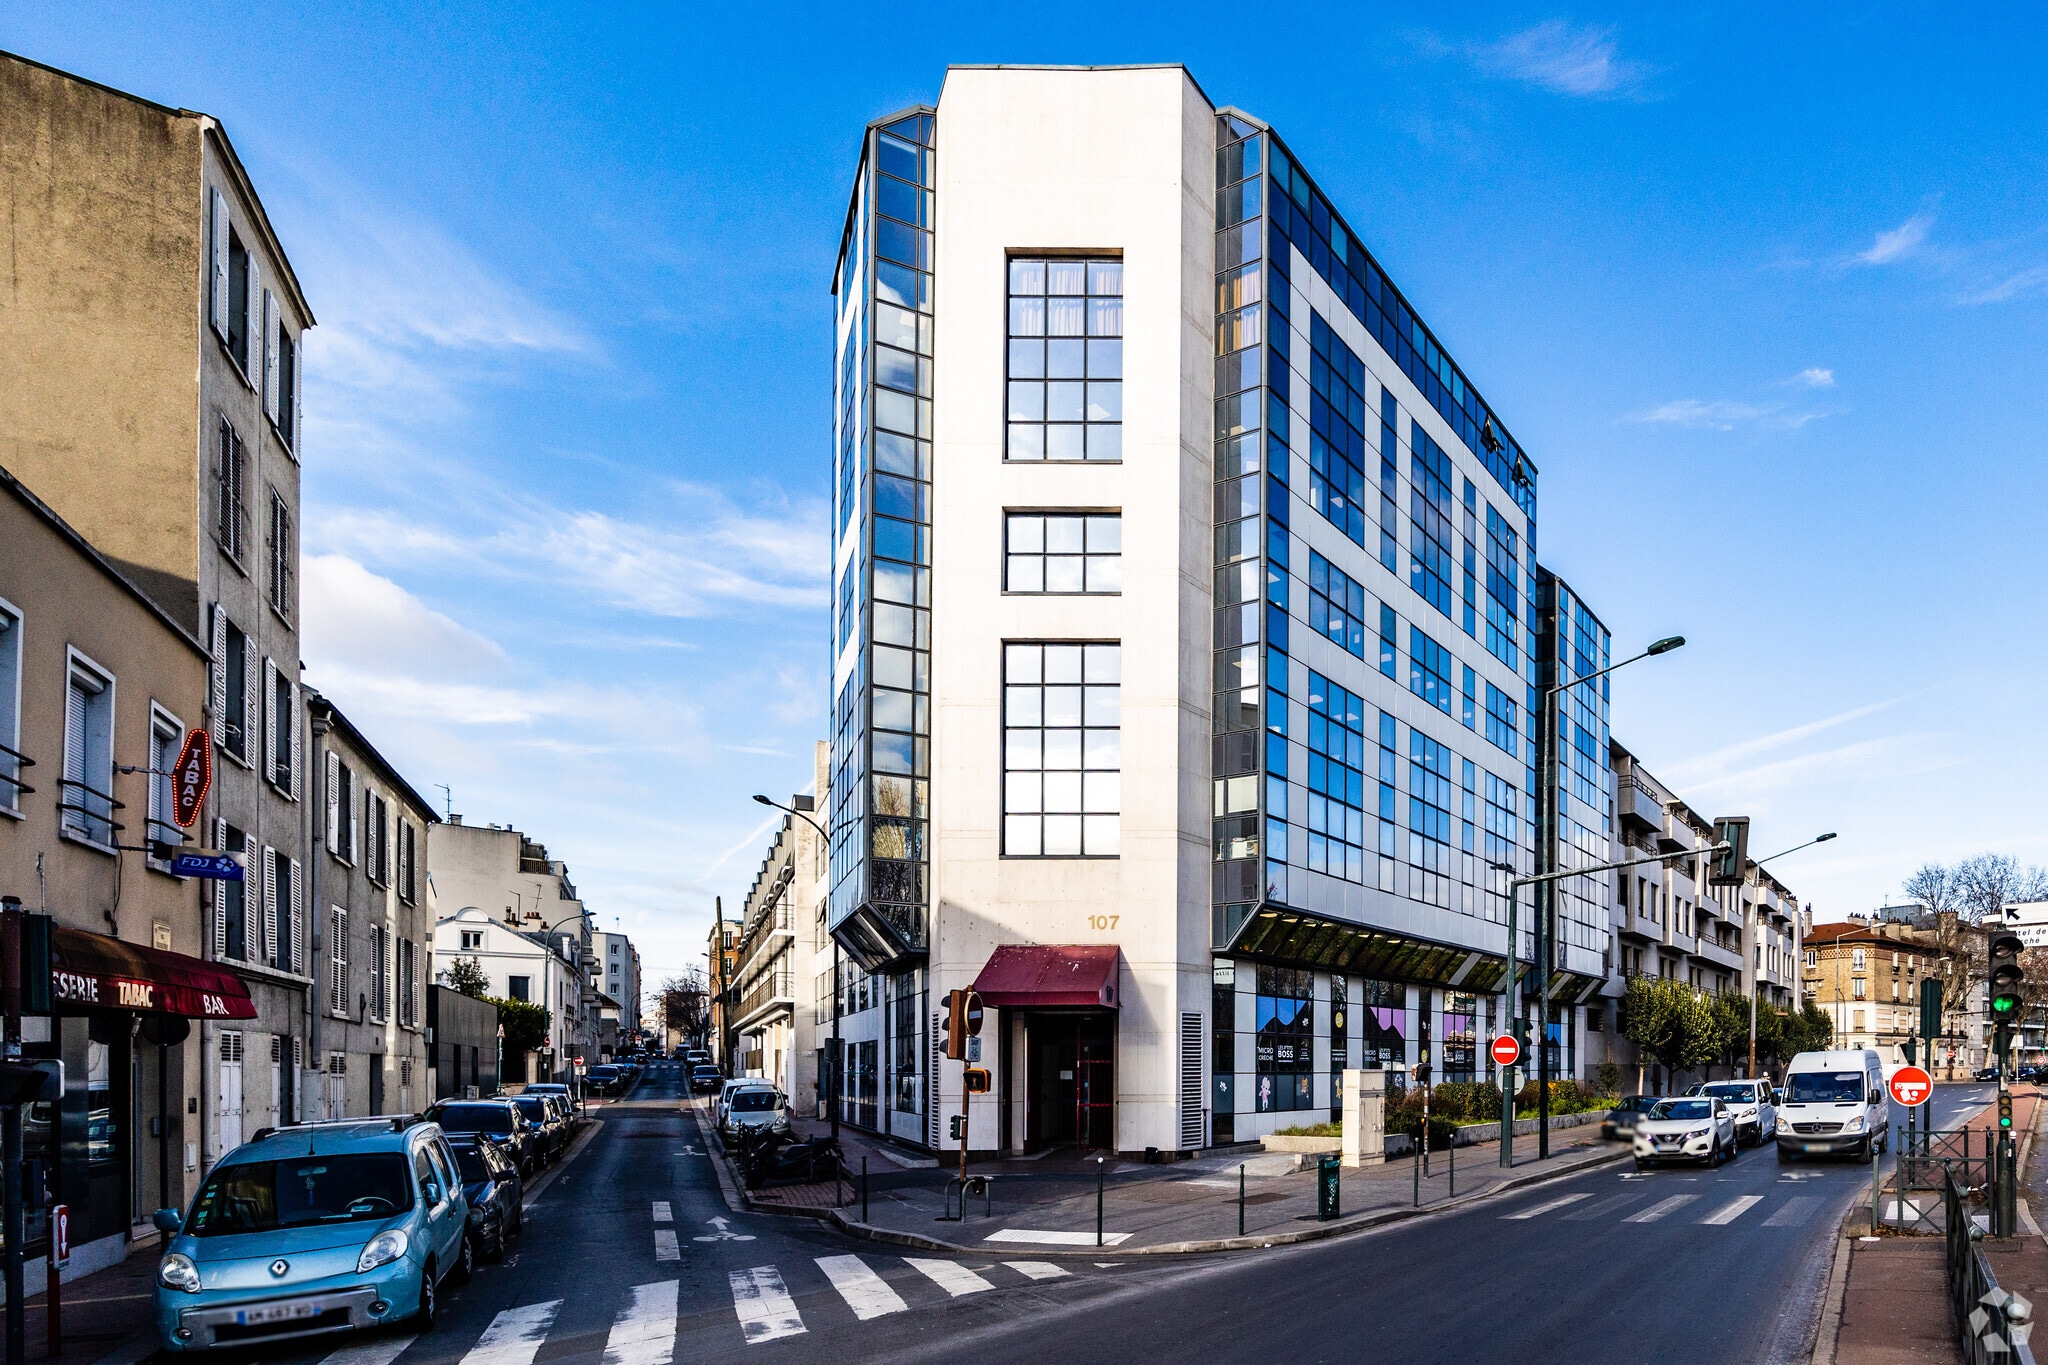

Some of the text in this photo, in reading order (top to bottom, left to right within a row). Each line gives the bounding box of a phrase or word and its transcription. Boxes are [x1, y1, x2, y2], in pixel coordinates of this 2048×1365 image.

[183, 748, 201, 807] TABAC
[181, 856, 210, 868] FDJ
[1088, 914, 1120, 930] 107
[118, 981, 153, 1008] TABAC
[203, 994, 230, 1015] BAR
[1258, 1046, 1274, 1054] MICRO
[1277, 1050, 1294, 1058] BOSS
